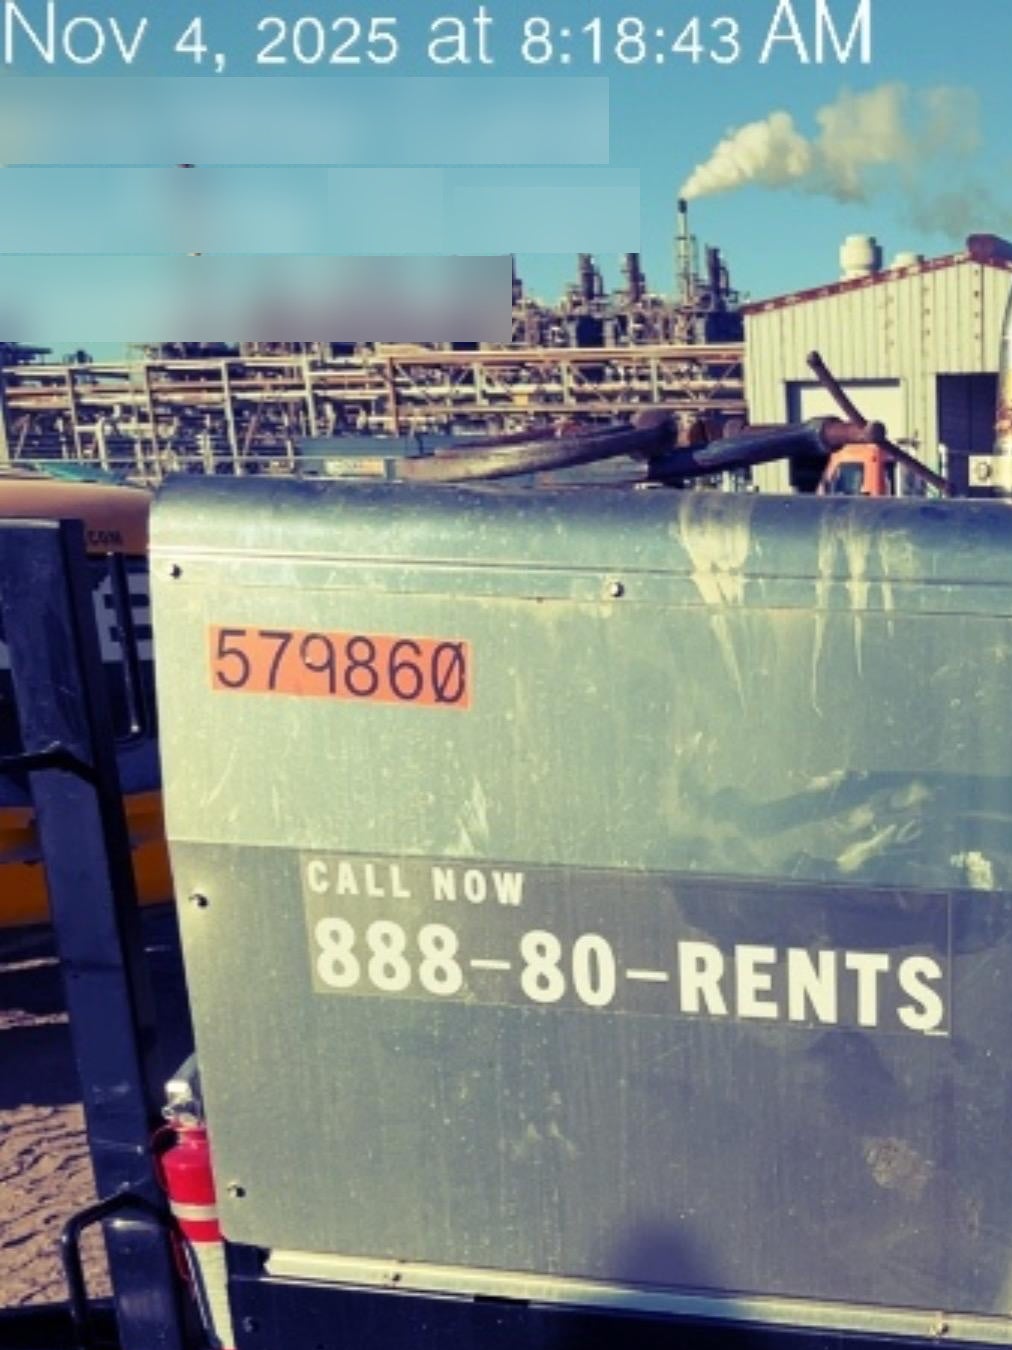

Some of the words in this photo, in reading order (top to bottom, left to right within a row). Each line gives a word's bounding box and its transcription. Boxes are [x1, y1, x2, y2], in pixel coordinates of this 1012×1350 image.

[217, 629, 466, 703] 579860
[306, 860, 413, 900] CALL
[432, 869, 525, 907] NOW
[313, 916, 946, 1032] 888-80-RENTS
